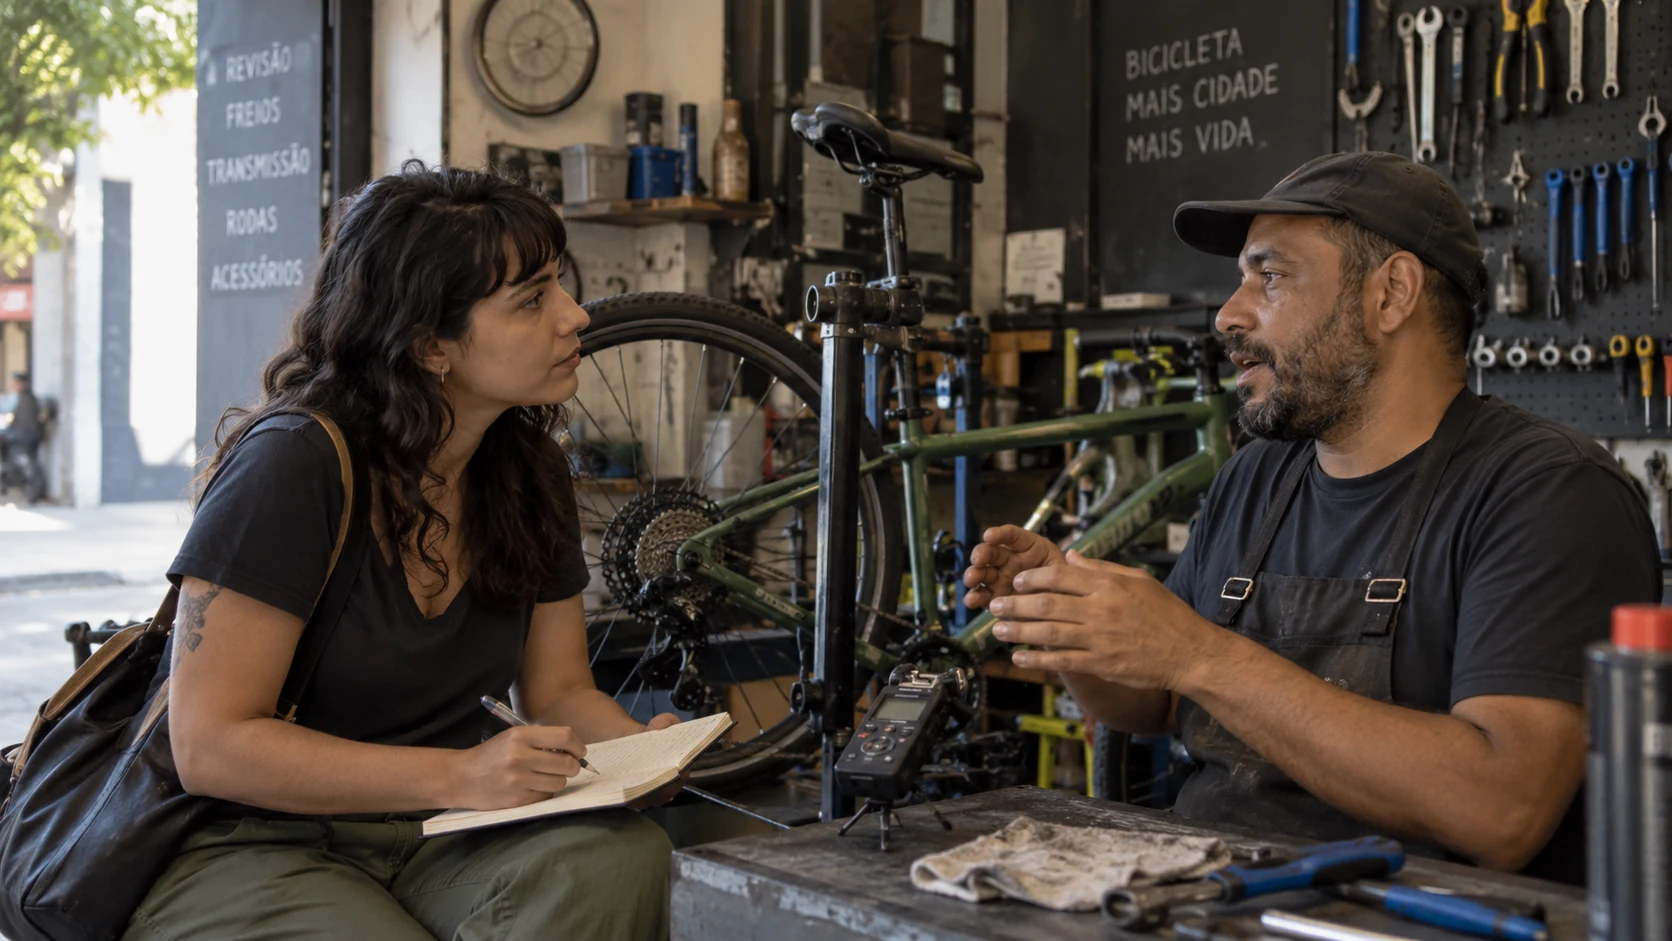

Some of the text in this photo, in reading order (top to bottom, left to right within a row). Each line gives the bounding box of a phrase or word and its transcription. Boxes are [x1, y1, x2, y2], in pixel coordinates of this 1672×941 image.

[226, 41, 292, 83] REVISÃO
[1126, 27, 1243, 80] BICICLETA
[1126, 63, 1279, 122] MAIS CIDADE
[226, 96, 281, 129] FREIOS
[206, 143, 311, 185] TRANSMISSÃO
[1126, 128, 1183, 165] MAIS
[226, 205, 278, 237] RODAS
[210, 254, 304, 291] ACESSÓRIOS
